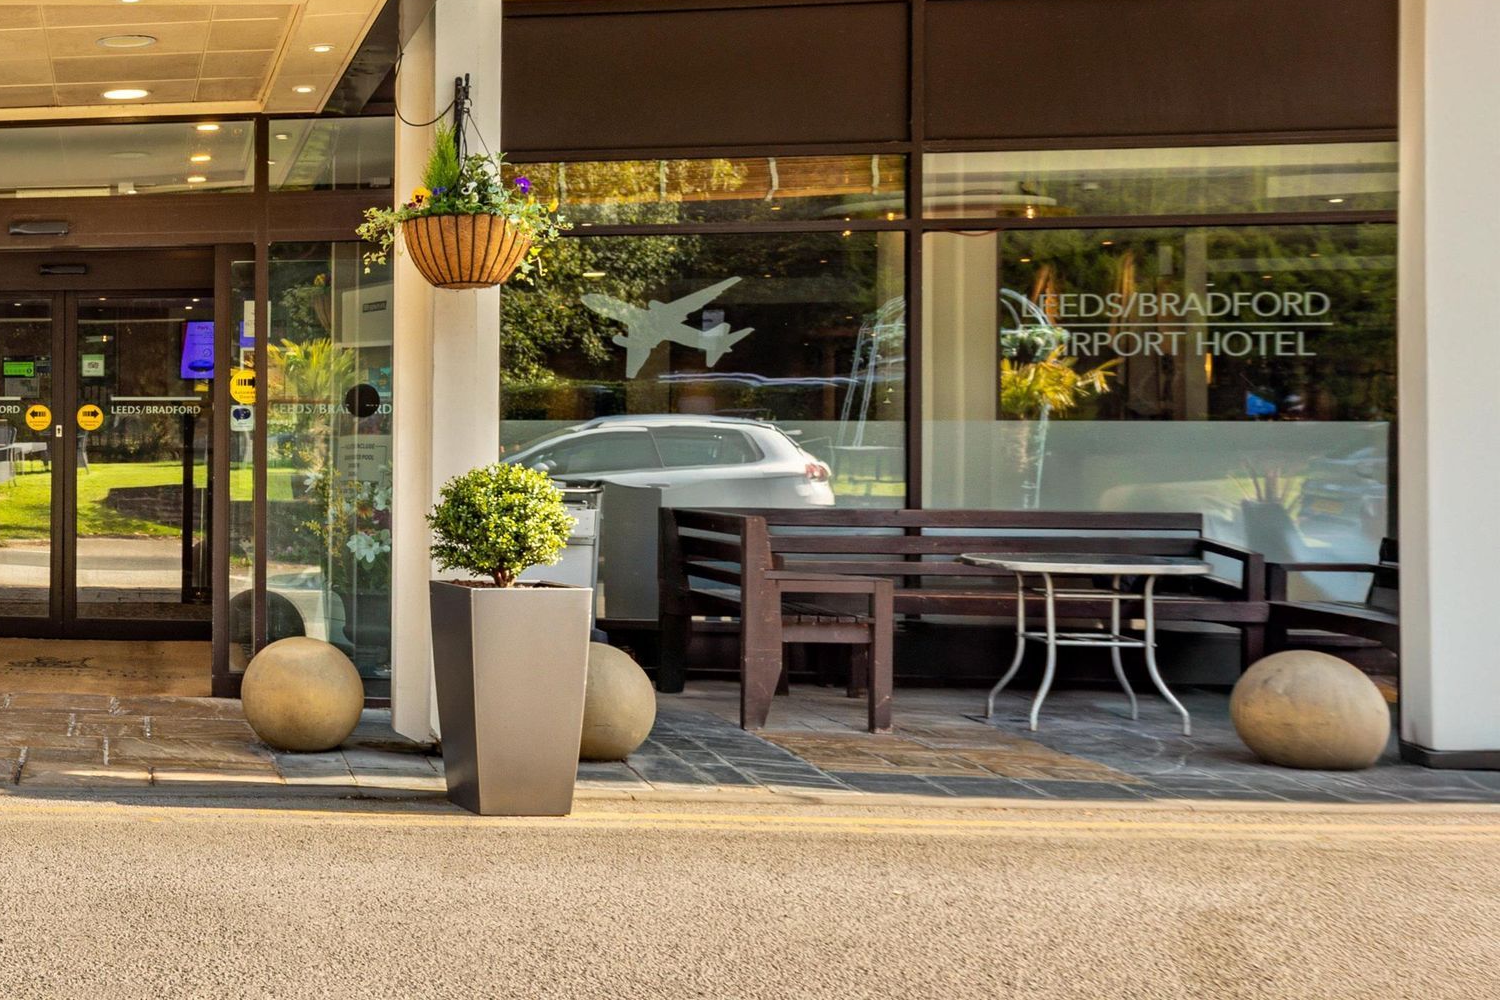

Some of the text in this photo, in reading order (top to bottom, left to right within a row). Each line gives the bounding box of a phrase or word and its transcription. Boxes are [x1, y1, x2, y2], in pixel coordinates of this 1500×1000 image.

[1021, 292, 1331, 317] LEEDS/BRADFORD
[1196, 331, 1316, 357] HOTEL
[110, 405, 201, 415] LEEDS/BRADFORD
